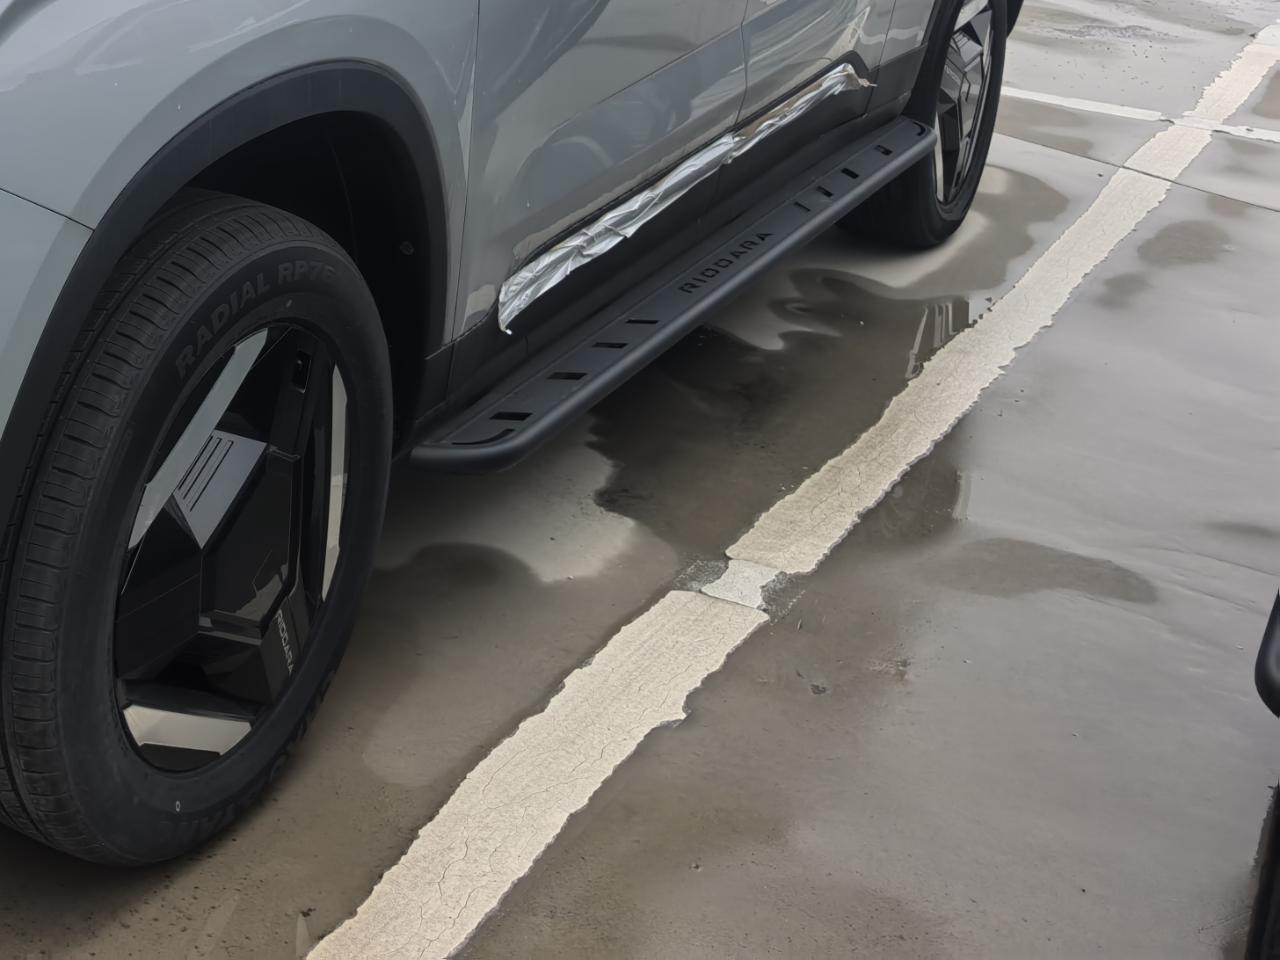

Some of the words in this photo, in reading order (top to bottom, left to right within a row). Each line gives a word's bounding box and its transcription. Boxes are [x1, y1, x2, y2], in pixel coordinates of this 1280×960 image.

[678, 232, 773, 293] RIDDARA
[176, 273, 271, 380] RADIAL
[275, 608, 294, 676] RIDDARA
